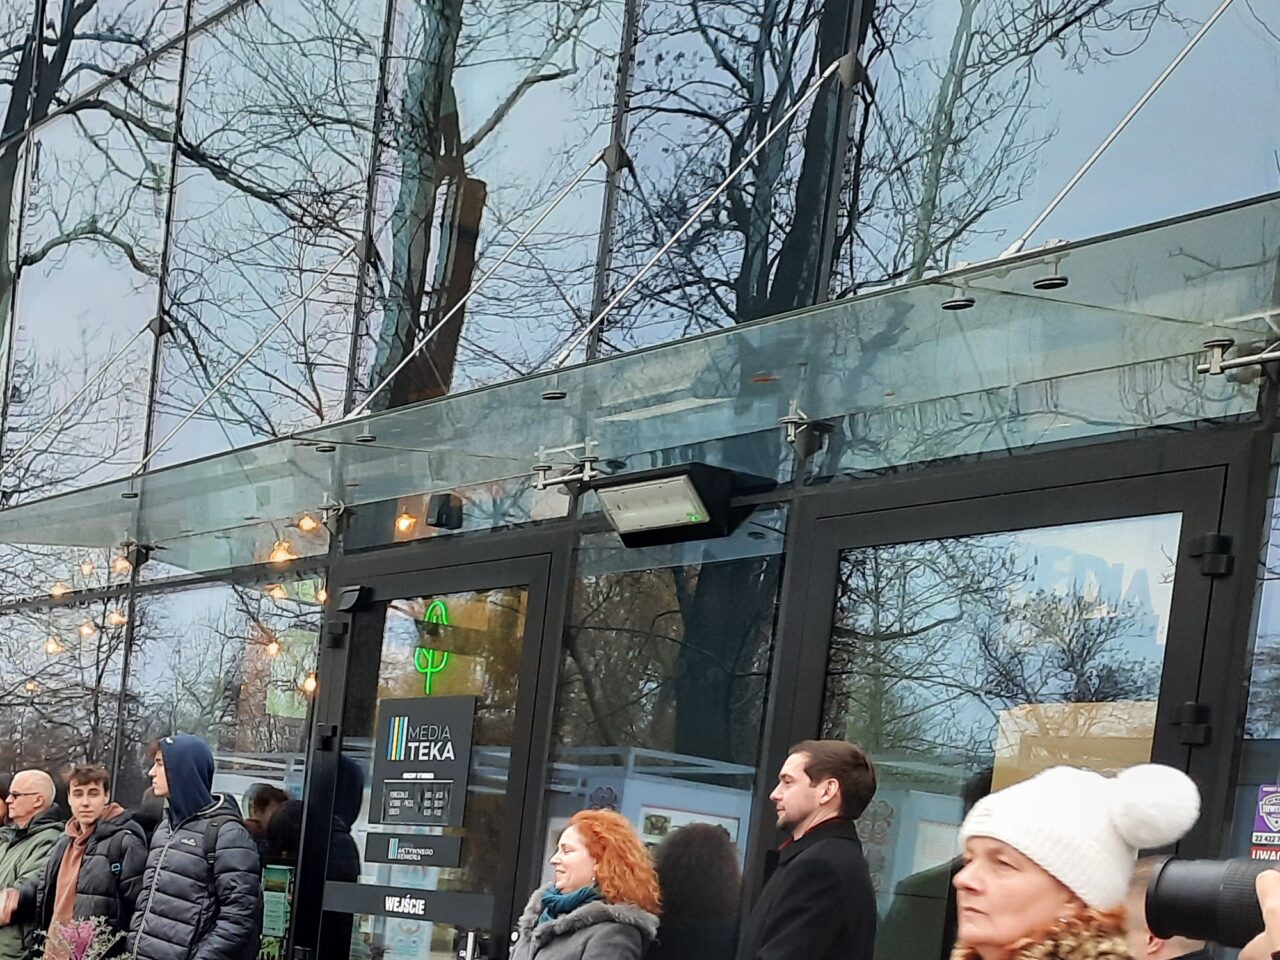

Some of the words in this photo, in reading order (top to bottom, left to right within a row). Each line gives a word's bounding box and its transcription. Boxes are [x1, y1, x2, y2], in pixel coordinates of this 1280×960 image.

[407, 725, 451, 740] MEDIA
[407, 741, 455, 761] TEKA
[385, 894, 426, 915] WEJŚCIE
